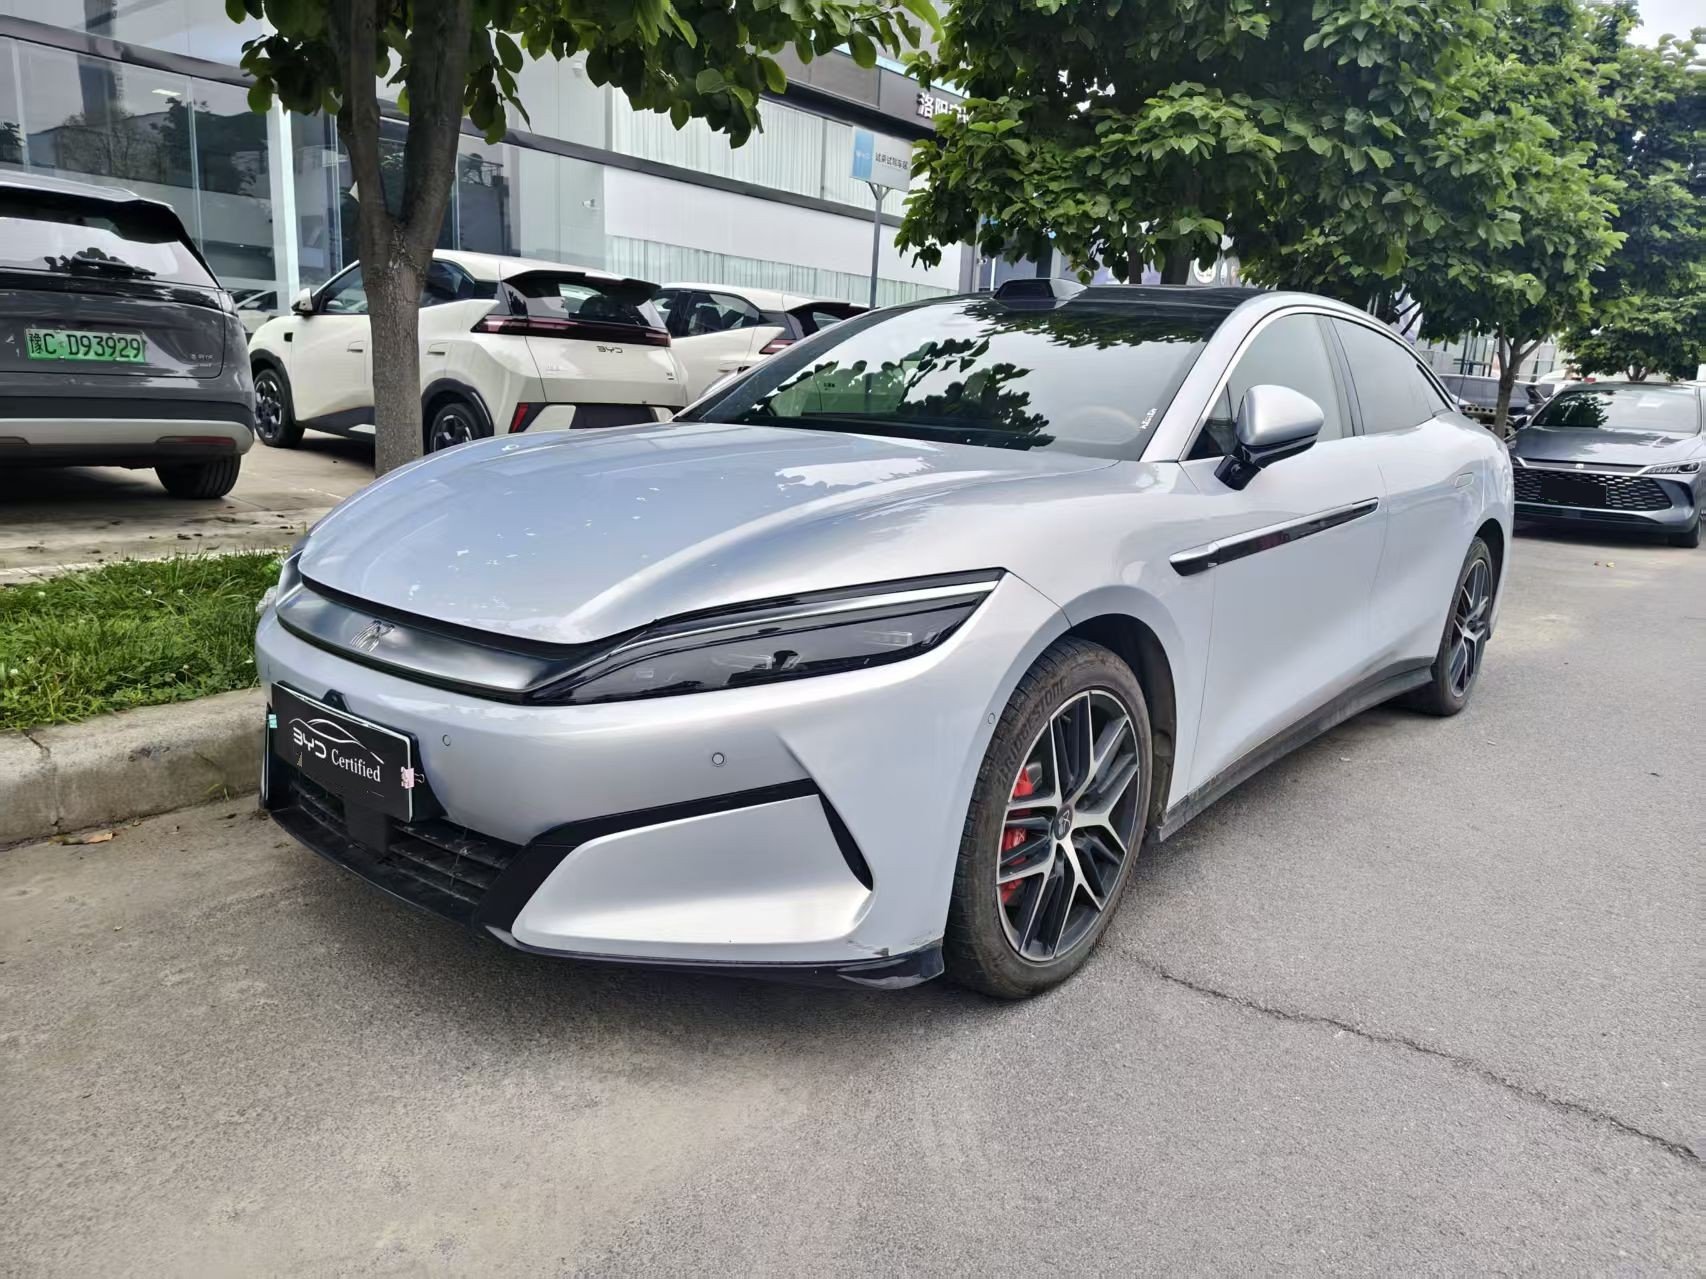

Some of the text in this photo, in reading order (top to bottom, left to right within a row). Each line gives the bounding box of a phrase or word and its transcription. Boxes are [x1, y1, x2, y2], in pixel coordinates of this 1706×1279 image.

[597, 345, 623, 354] BYD
[293, 727, 381, 782] BYD Certified
